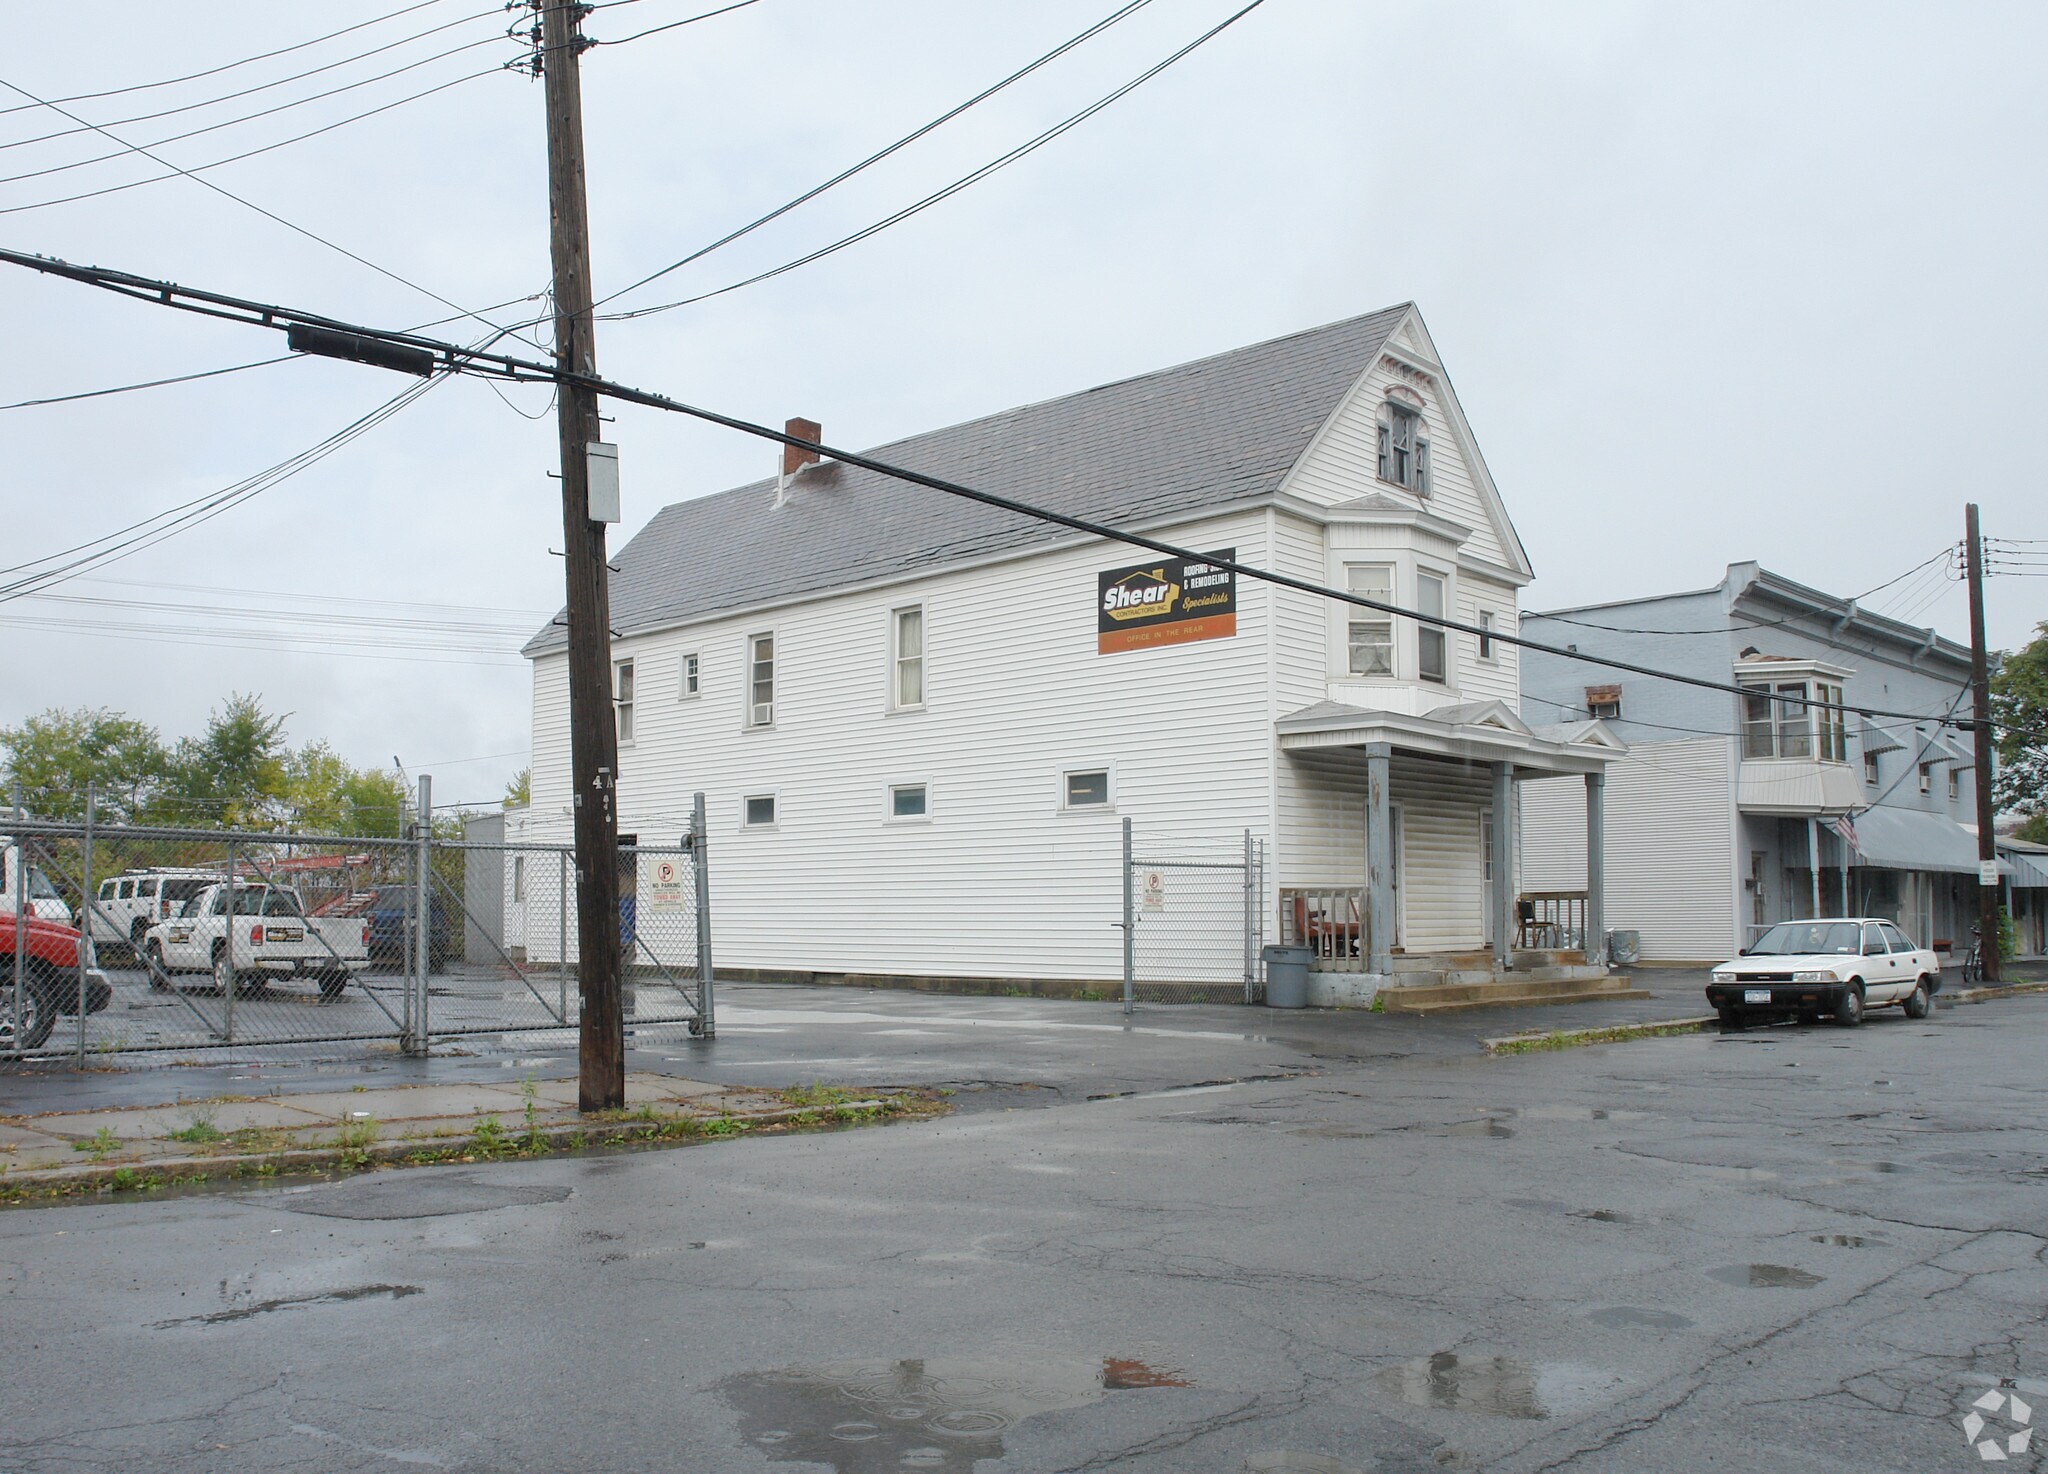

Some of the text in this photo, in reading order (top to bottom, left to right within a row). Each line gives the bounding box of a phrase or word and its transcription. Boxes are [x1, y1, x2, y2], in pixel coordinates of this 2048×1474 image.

[1190, 572, 1230, 589] REMODELING
[1103, 585, 1168, 610] Shear
[1182, 592, 1228, 612] Specialists
[1116, 606, 1156, 618] CONTRACTORS
[1127, 633, 1150, 643] OFFICE
[1166, 629, 1180, 637] THE
[1184, 625, 1204, 634] REAR
[592, 775, 614, 790] 4 A
